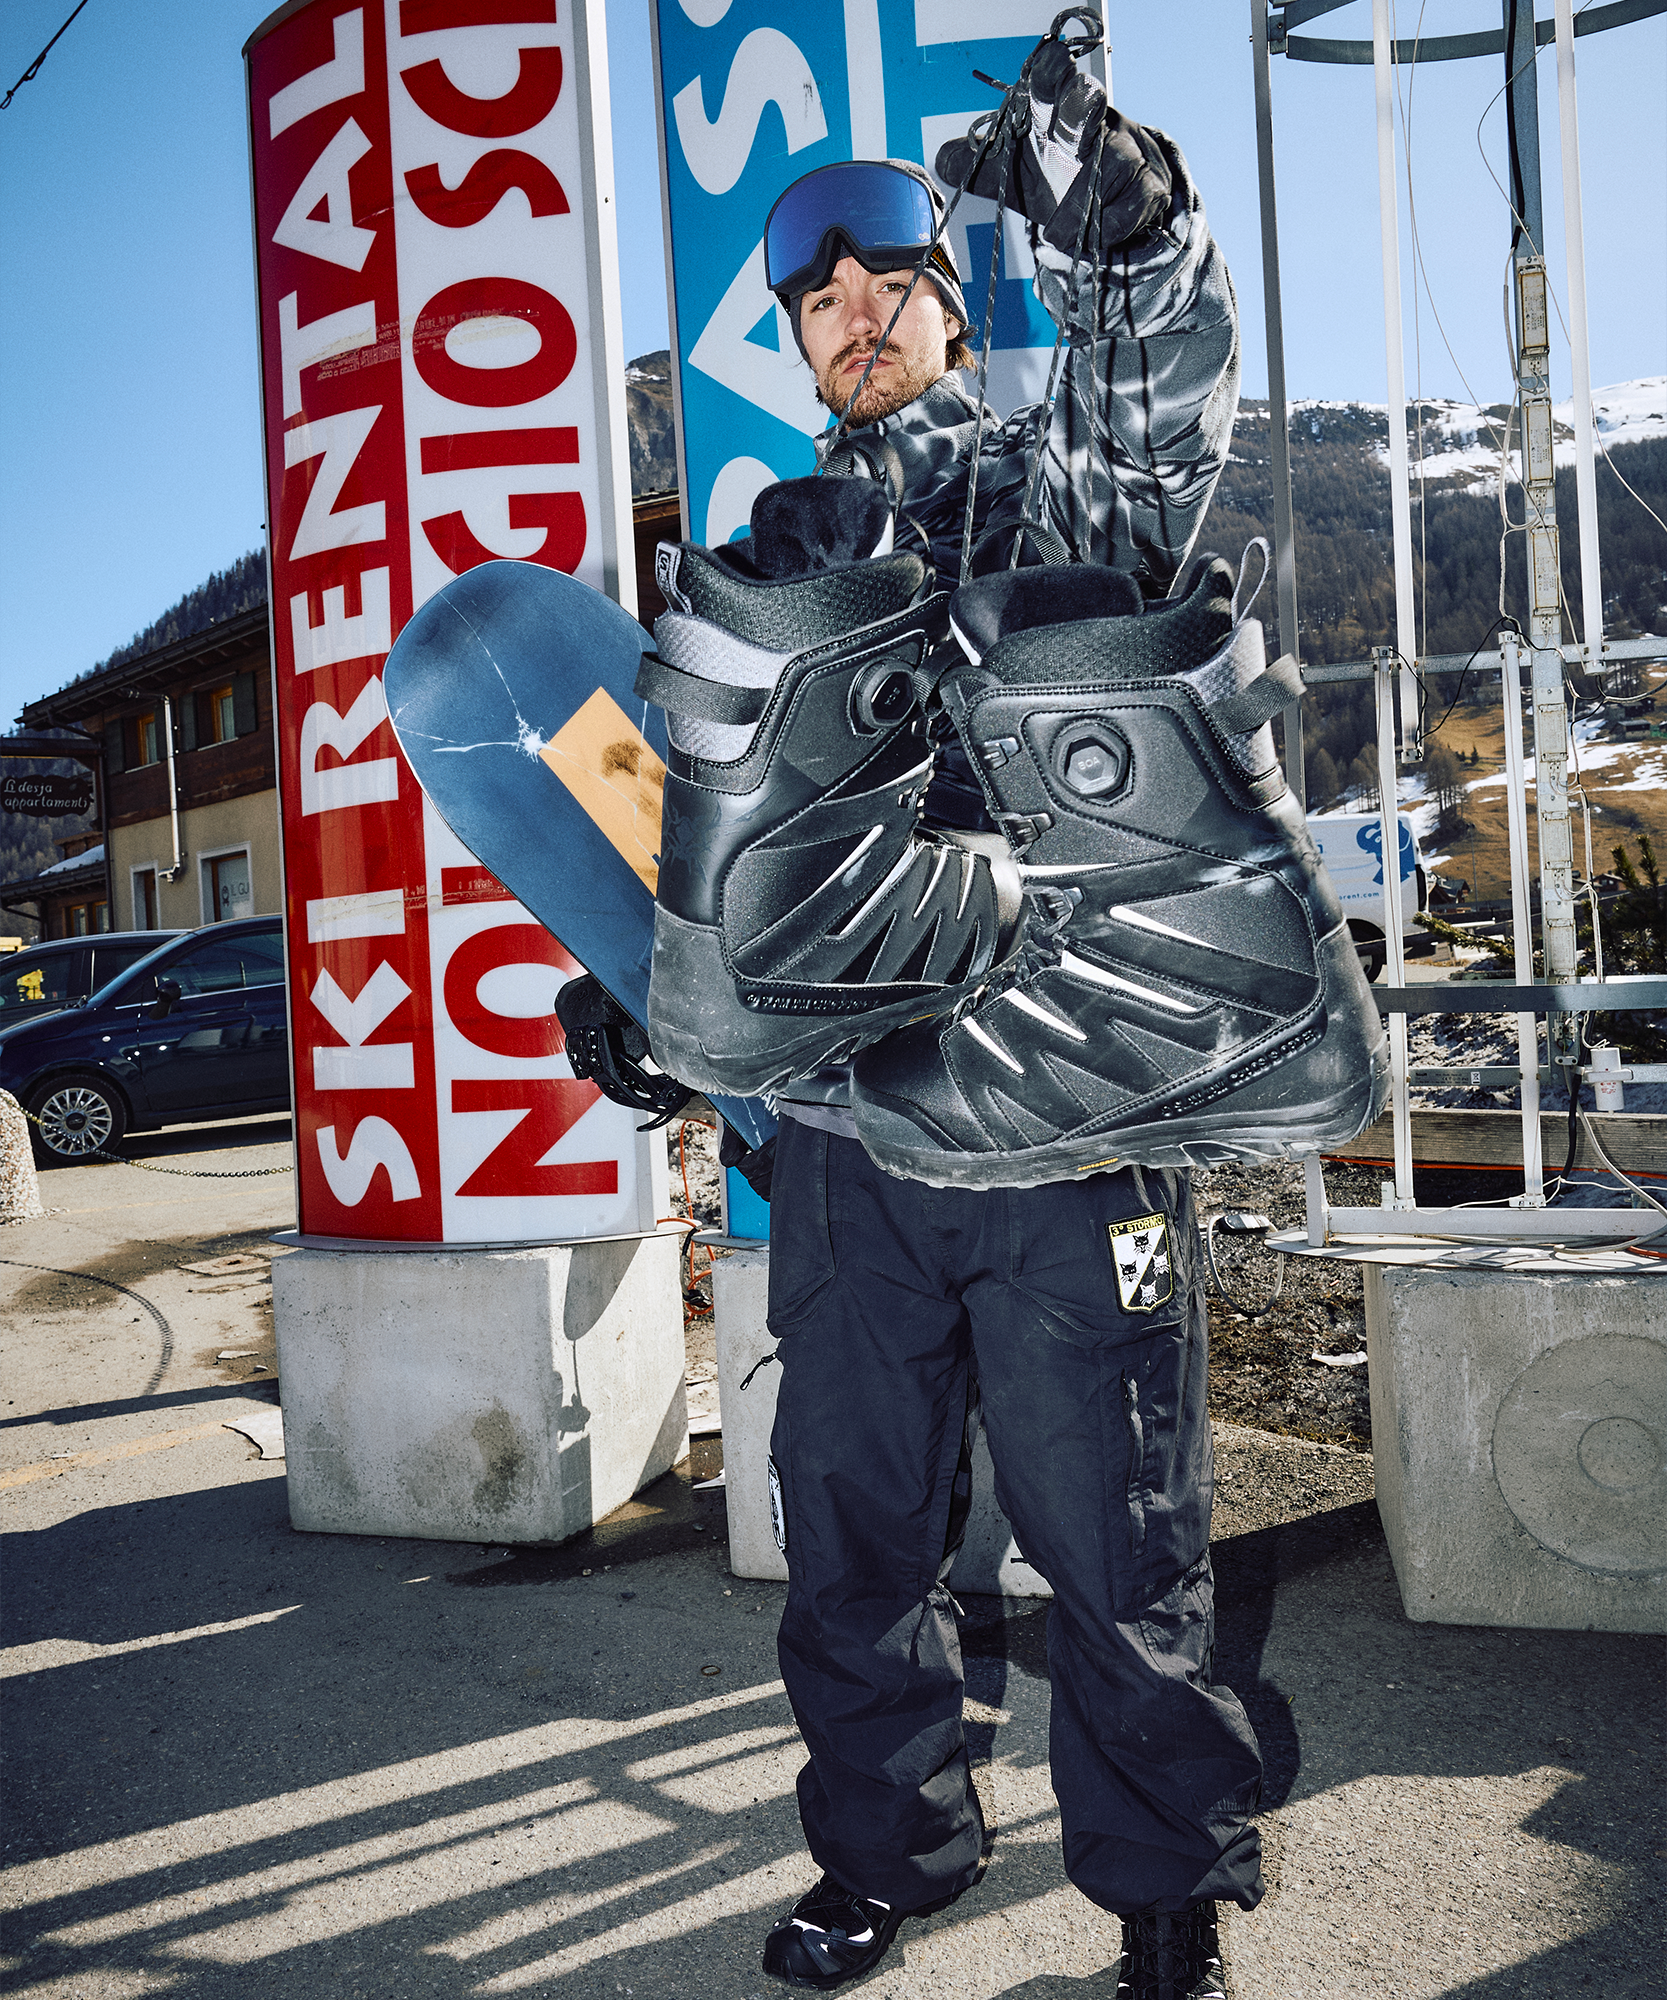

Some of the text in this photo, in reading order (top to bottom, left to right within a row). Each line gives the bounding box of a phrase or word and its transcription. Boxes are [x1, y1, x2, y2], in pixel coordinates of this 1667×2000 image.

[269, 7, 399, 816] RENTAL
[5, 796, 88, 810] appartamenti
[412, 276, 618, 1197] NOGIO
[1078, 756, 1100, 770] BOA
[307, 889, 422, 1208] SKI
[1112, 1216, 1163, 1236] 3° STORMO
